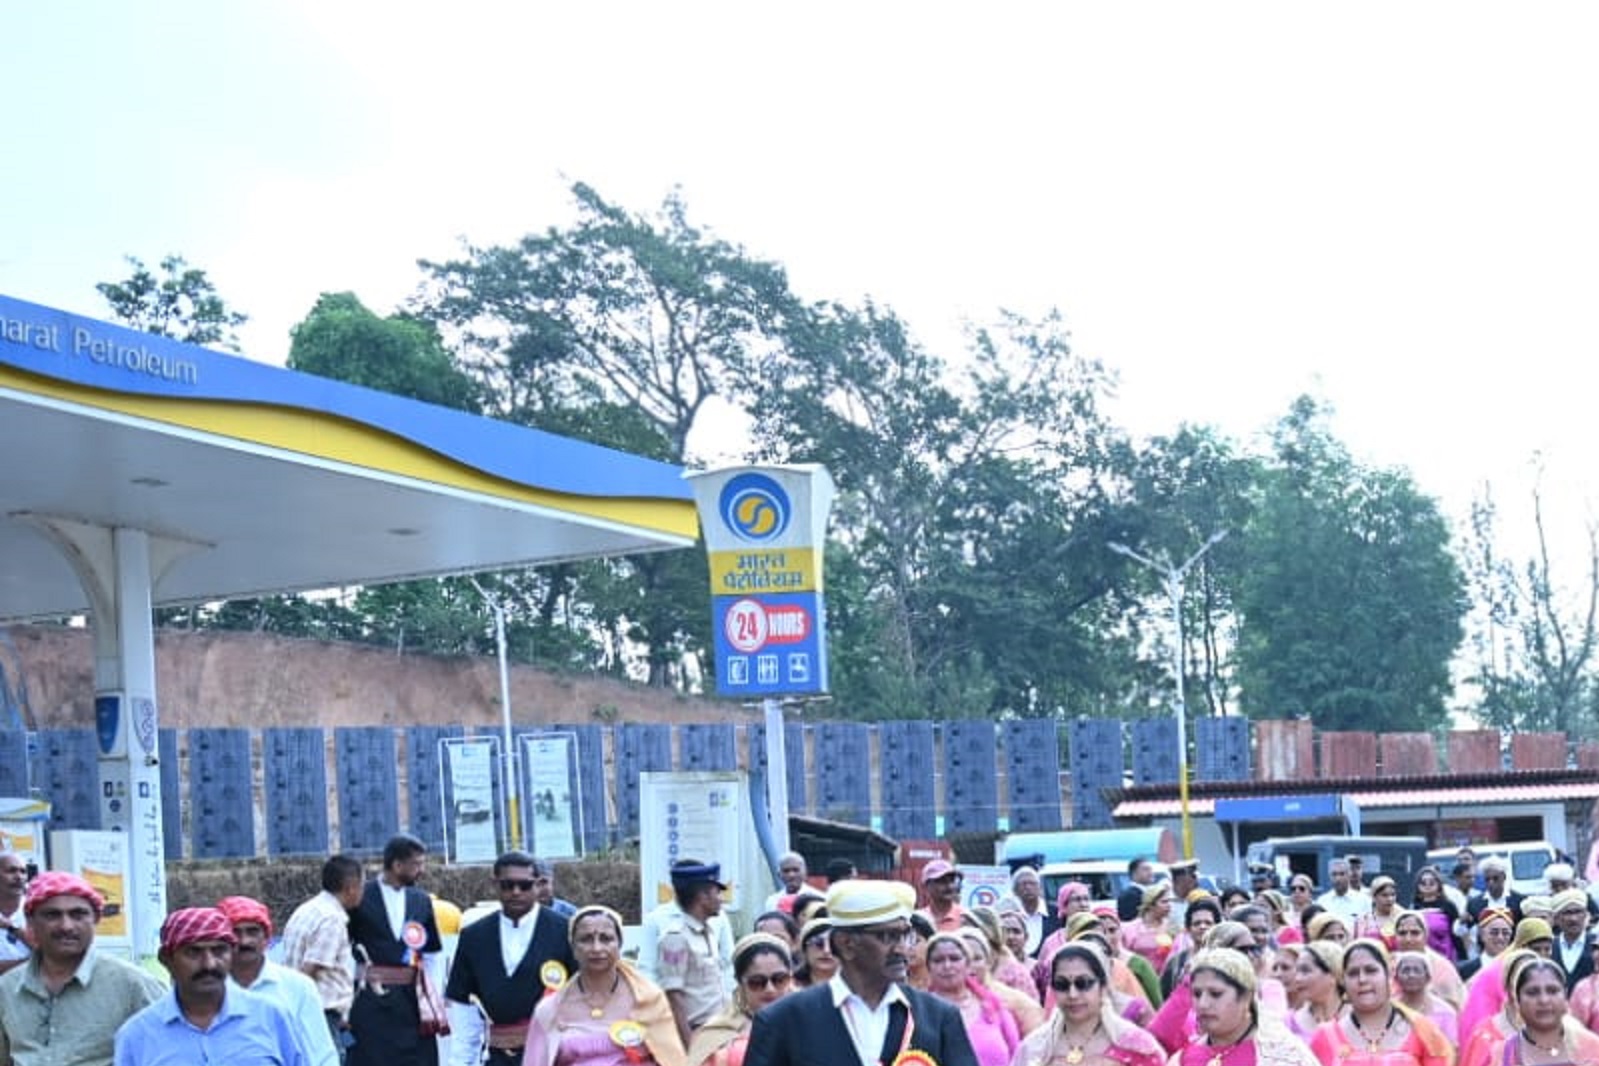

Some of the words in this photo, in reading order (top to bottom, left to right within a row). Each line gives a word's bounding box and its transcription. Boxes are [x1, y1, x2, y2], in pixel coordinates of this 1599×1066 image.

[74, 326, 199, 385] Petroleum
[735, 552, 786, 571] भारत
[736, 611, 759, 641] 24
[768, 610, 806, 637] HOURS
